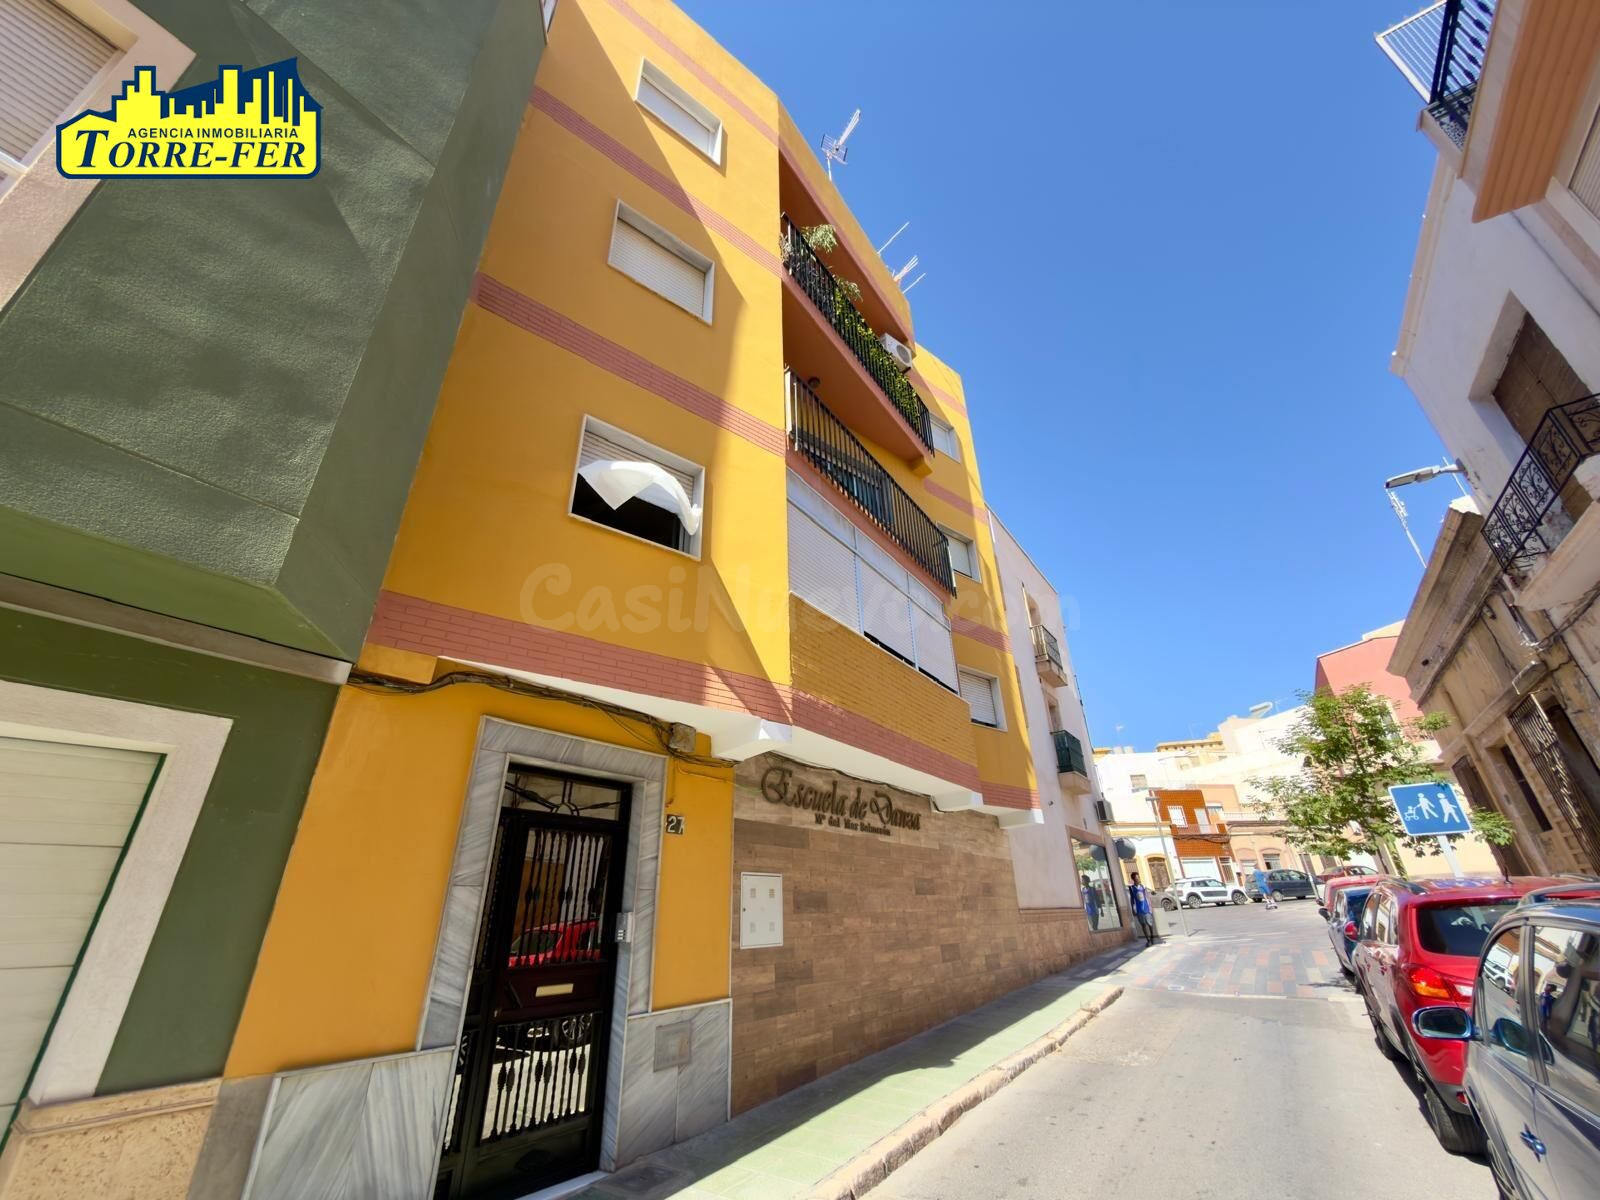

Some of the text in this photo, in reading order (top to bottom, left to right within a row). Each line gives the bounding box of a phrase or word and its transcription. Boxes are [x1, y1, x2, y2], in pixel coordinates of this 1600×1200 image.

[760, 766, 922, 831] Escuela de Danza
[667, 814, 685, 834] 27
